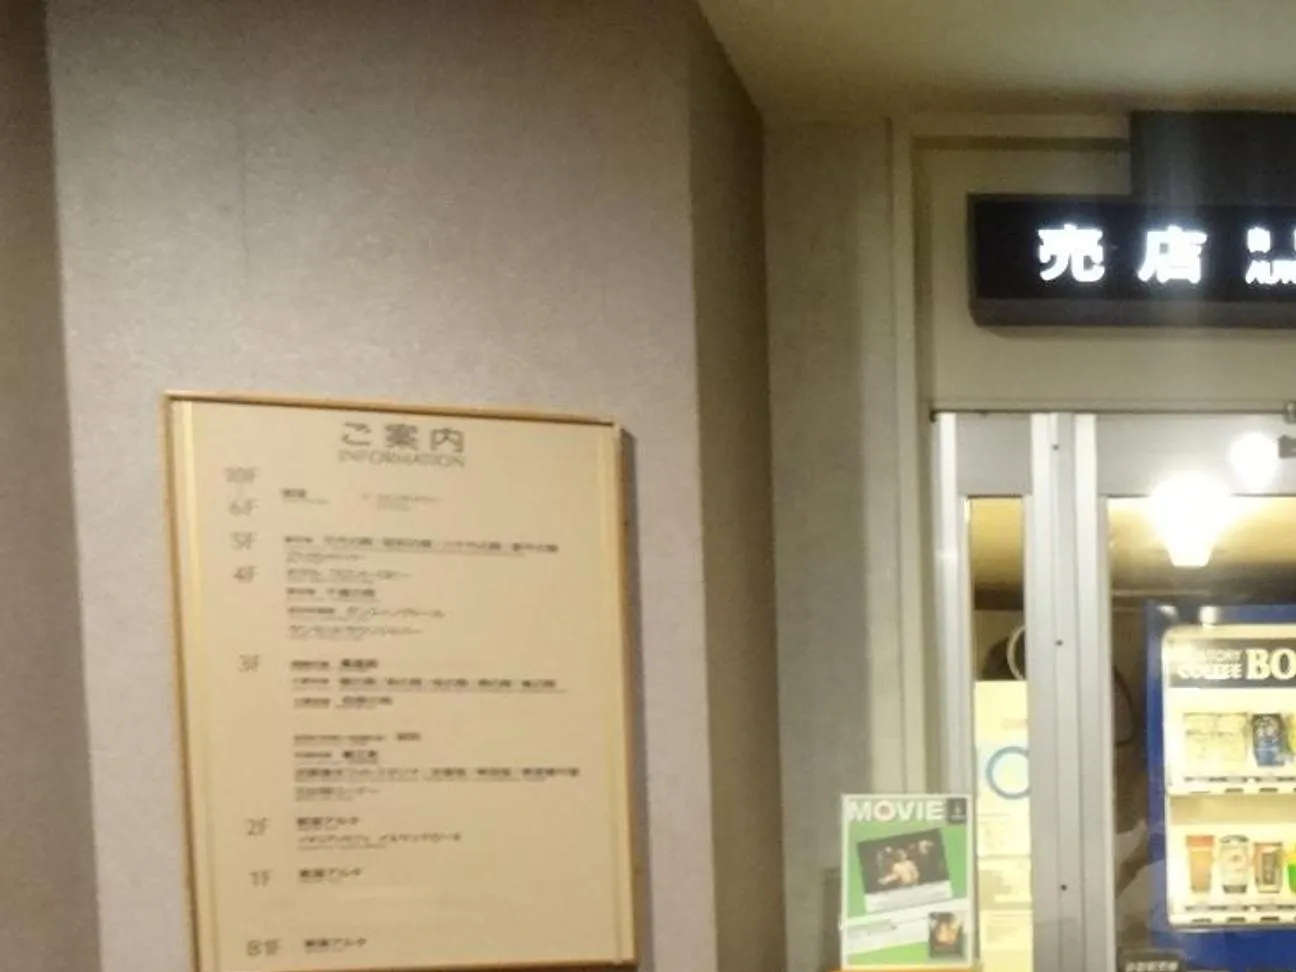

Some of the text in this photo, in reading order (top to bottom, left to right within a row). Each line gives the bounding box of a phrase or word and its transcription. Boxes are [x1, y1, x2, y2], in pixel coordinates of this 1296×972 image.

[1037, 223, 1207, 284] 売店
[341, 420, 465, 453] ご案内
[848, 799, 945, 823] MOVIE
